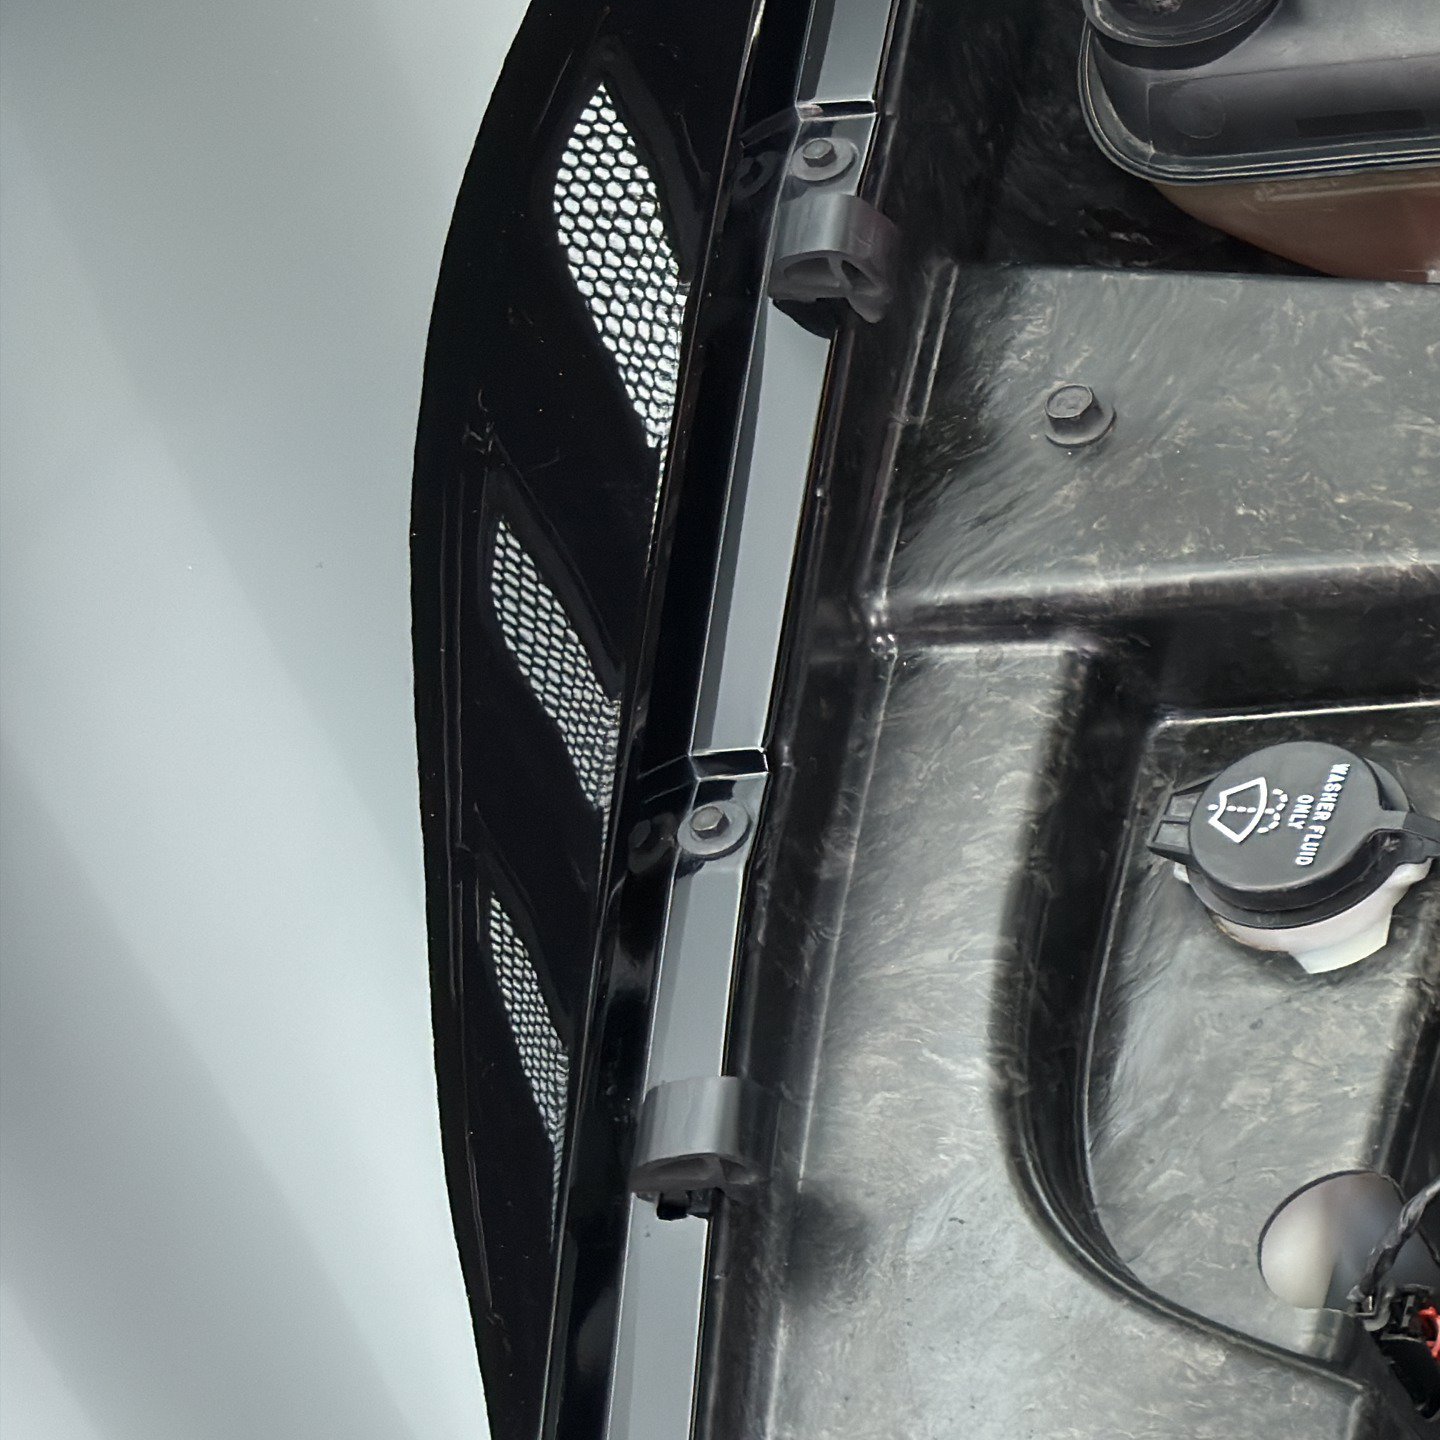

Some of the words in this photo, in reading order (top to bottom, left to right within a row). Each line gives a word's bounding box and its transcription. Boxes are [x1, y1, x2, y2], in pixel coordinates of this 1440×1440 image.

[1288, 794, 1315, 829] ONLY
[1316, 763, 1350, 822] WASHER
[1295, 824, 1327, 866] FLUID
